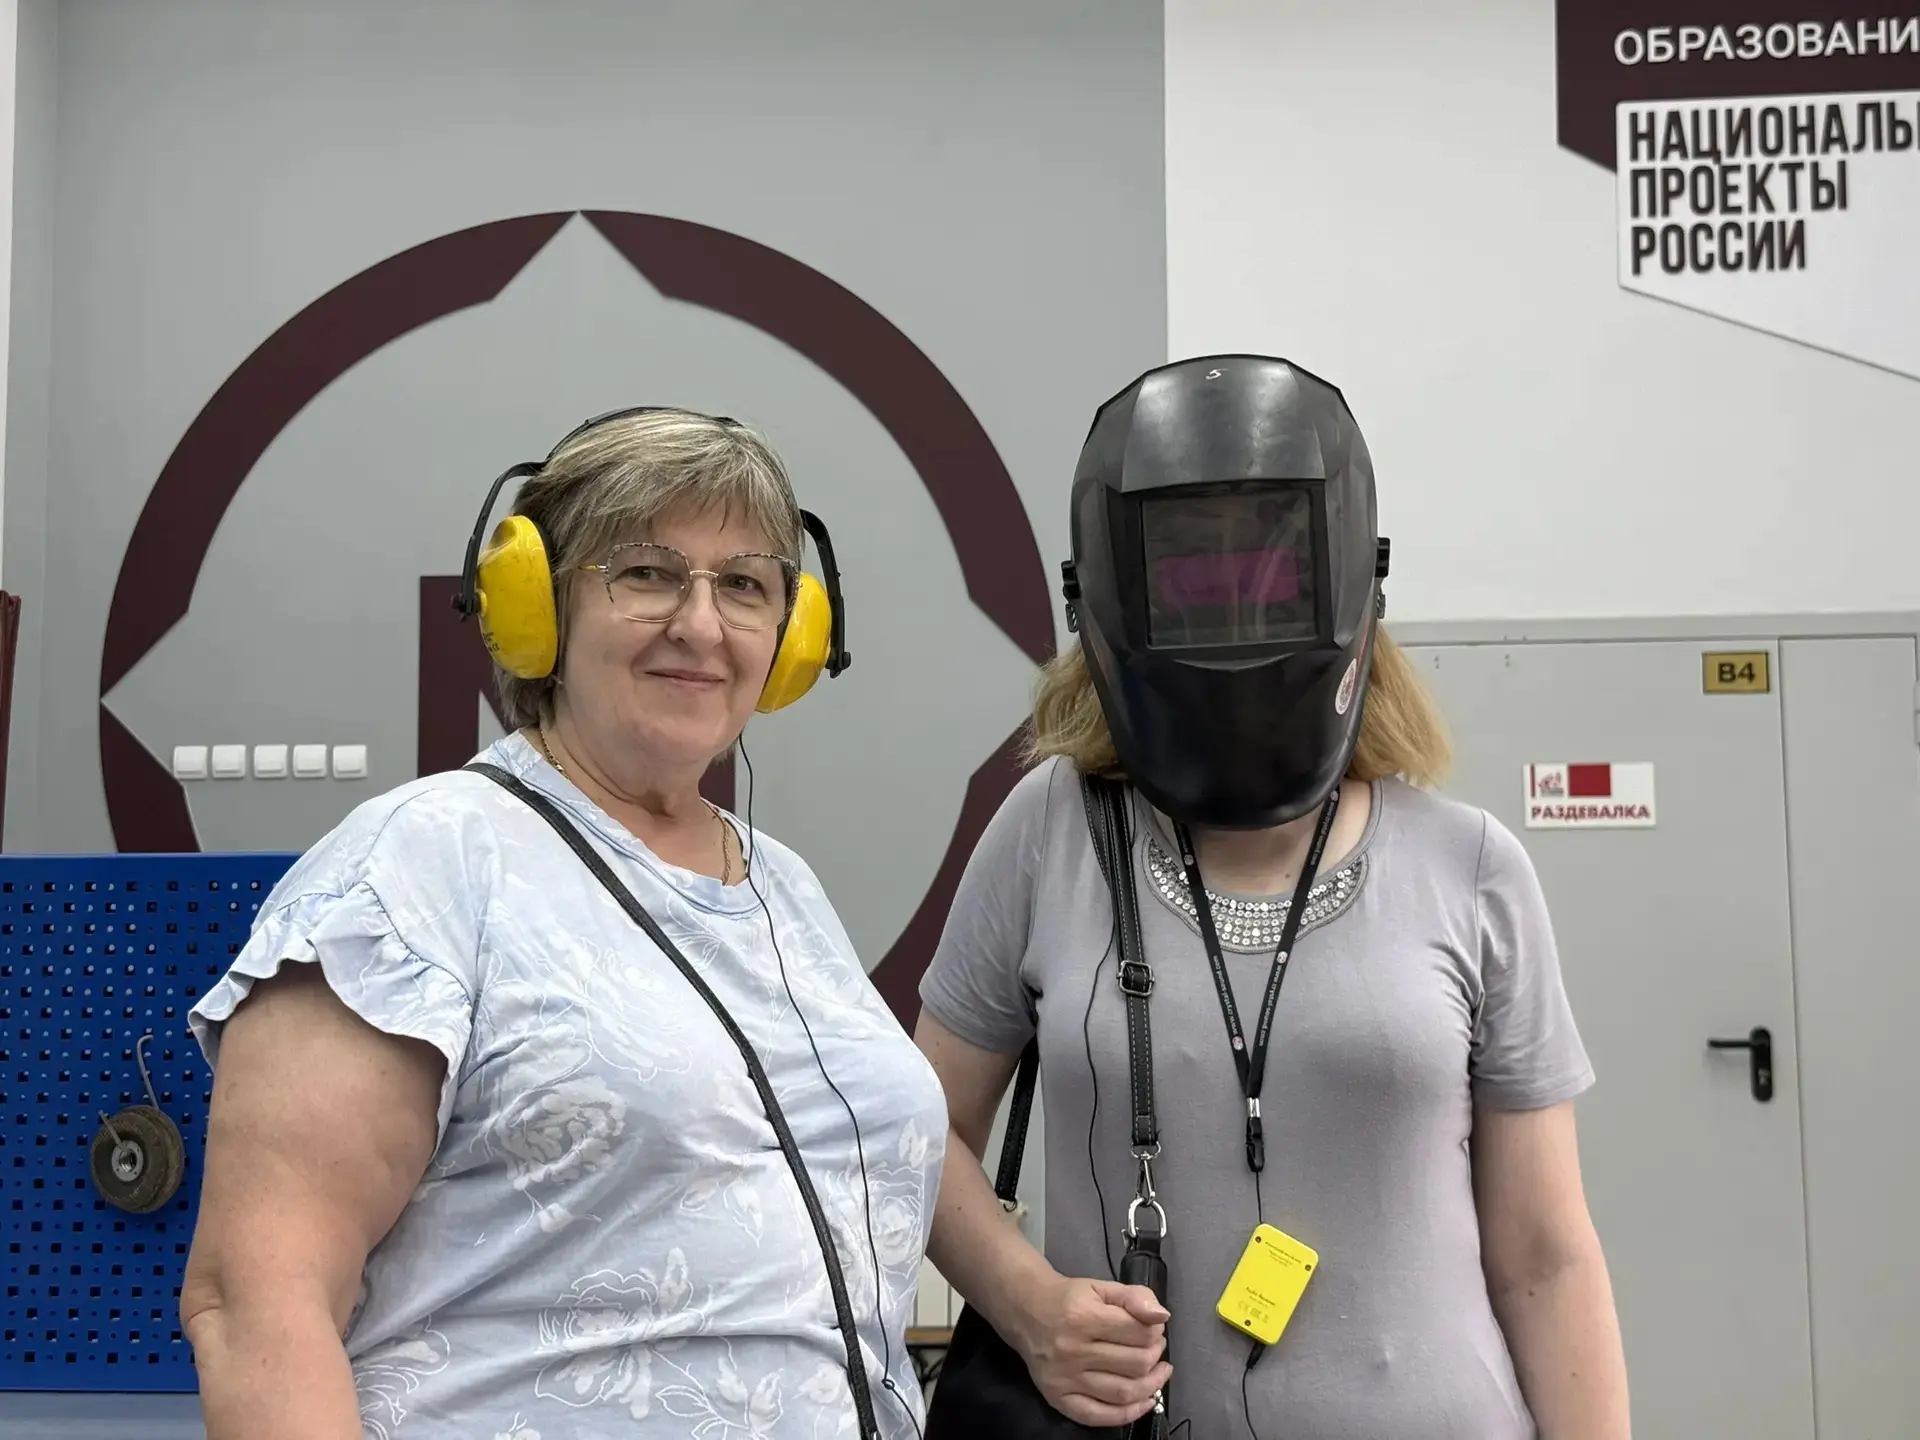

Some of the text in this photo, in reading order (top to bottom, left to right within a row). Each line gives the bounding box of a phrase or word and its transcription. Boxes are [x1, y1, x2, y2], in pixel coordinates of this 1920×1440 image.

[1614, 17, 1920, 65] ОБРАЗОВАНИ
[1629, 101, 1920, 164] НАЦИОНАЛЬ
[1629, 160, 1848, 219] ПРОЕКТЫ
[1630, 219, 1806, 276] РОССИИ
[1531, 804, 1650, 821] РАЗДЕВАЛКА
